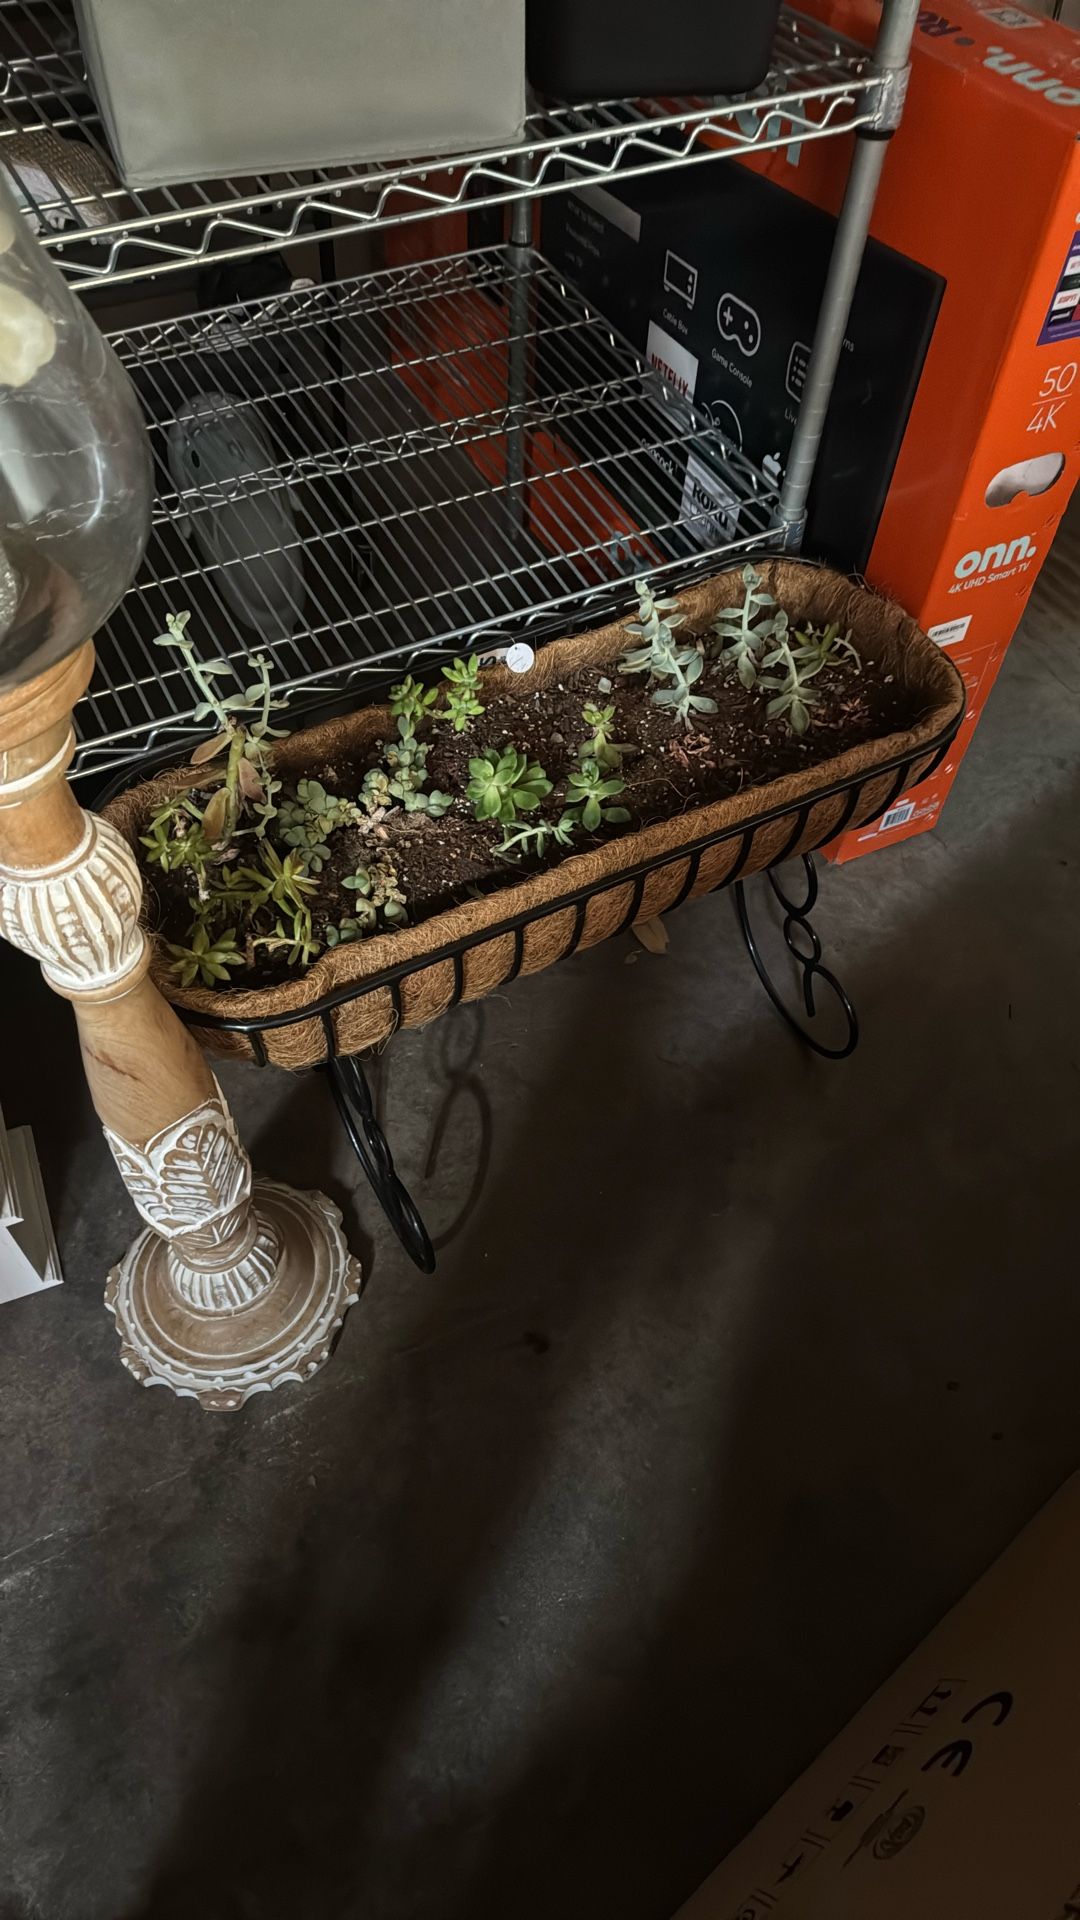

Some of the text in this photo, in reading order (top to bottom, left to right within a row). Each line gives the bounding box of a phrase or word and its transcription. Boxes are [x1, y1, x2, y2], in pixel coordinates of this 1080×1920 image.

[662, 307, 689, 335] Cable Box
[711, 347, 753, 389] Game Console
[1039, 361, 1078, 397] 50
[1026, 401, 1066, 434] 4K
[954, 535, 1037, 579] onn.
[948, 560, 1032, 594] 4K UHD Smart TV
